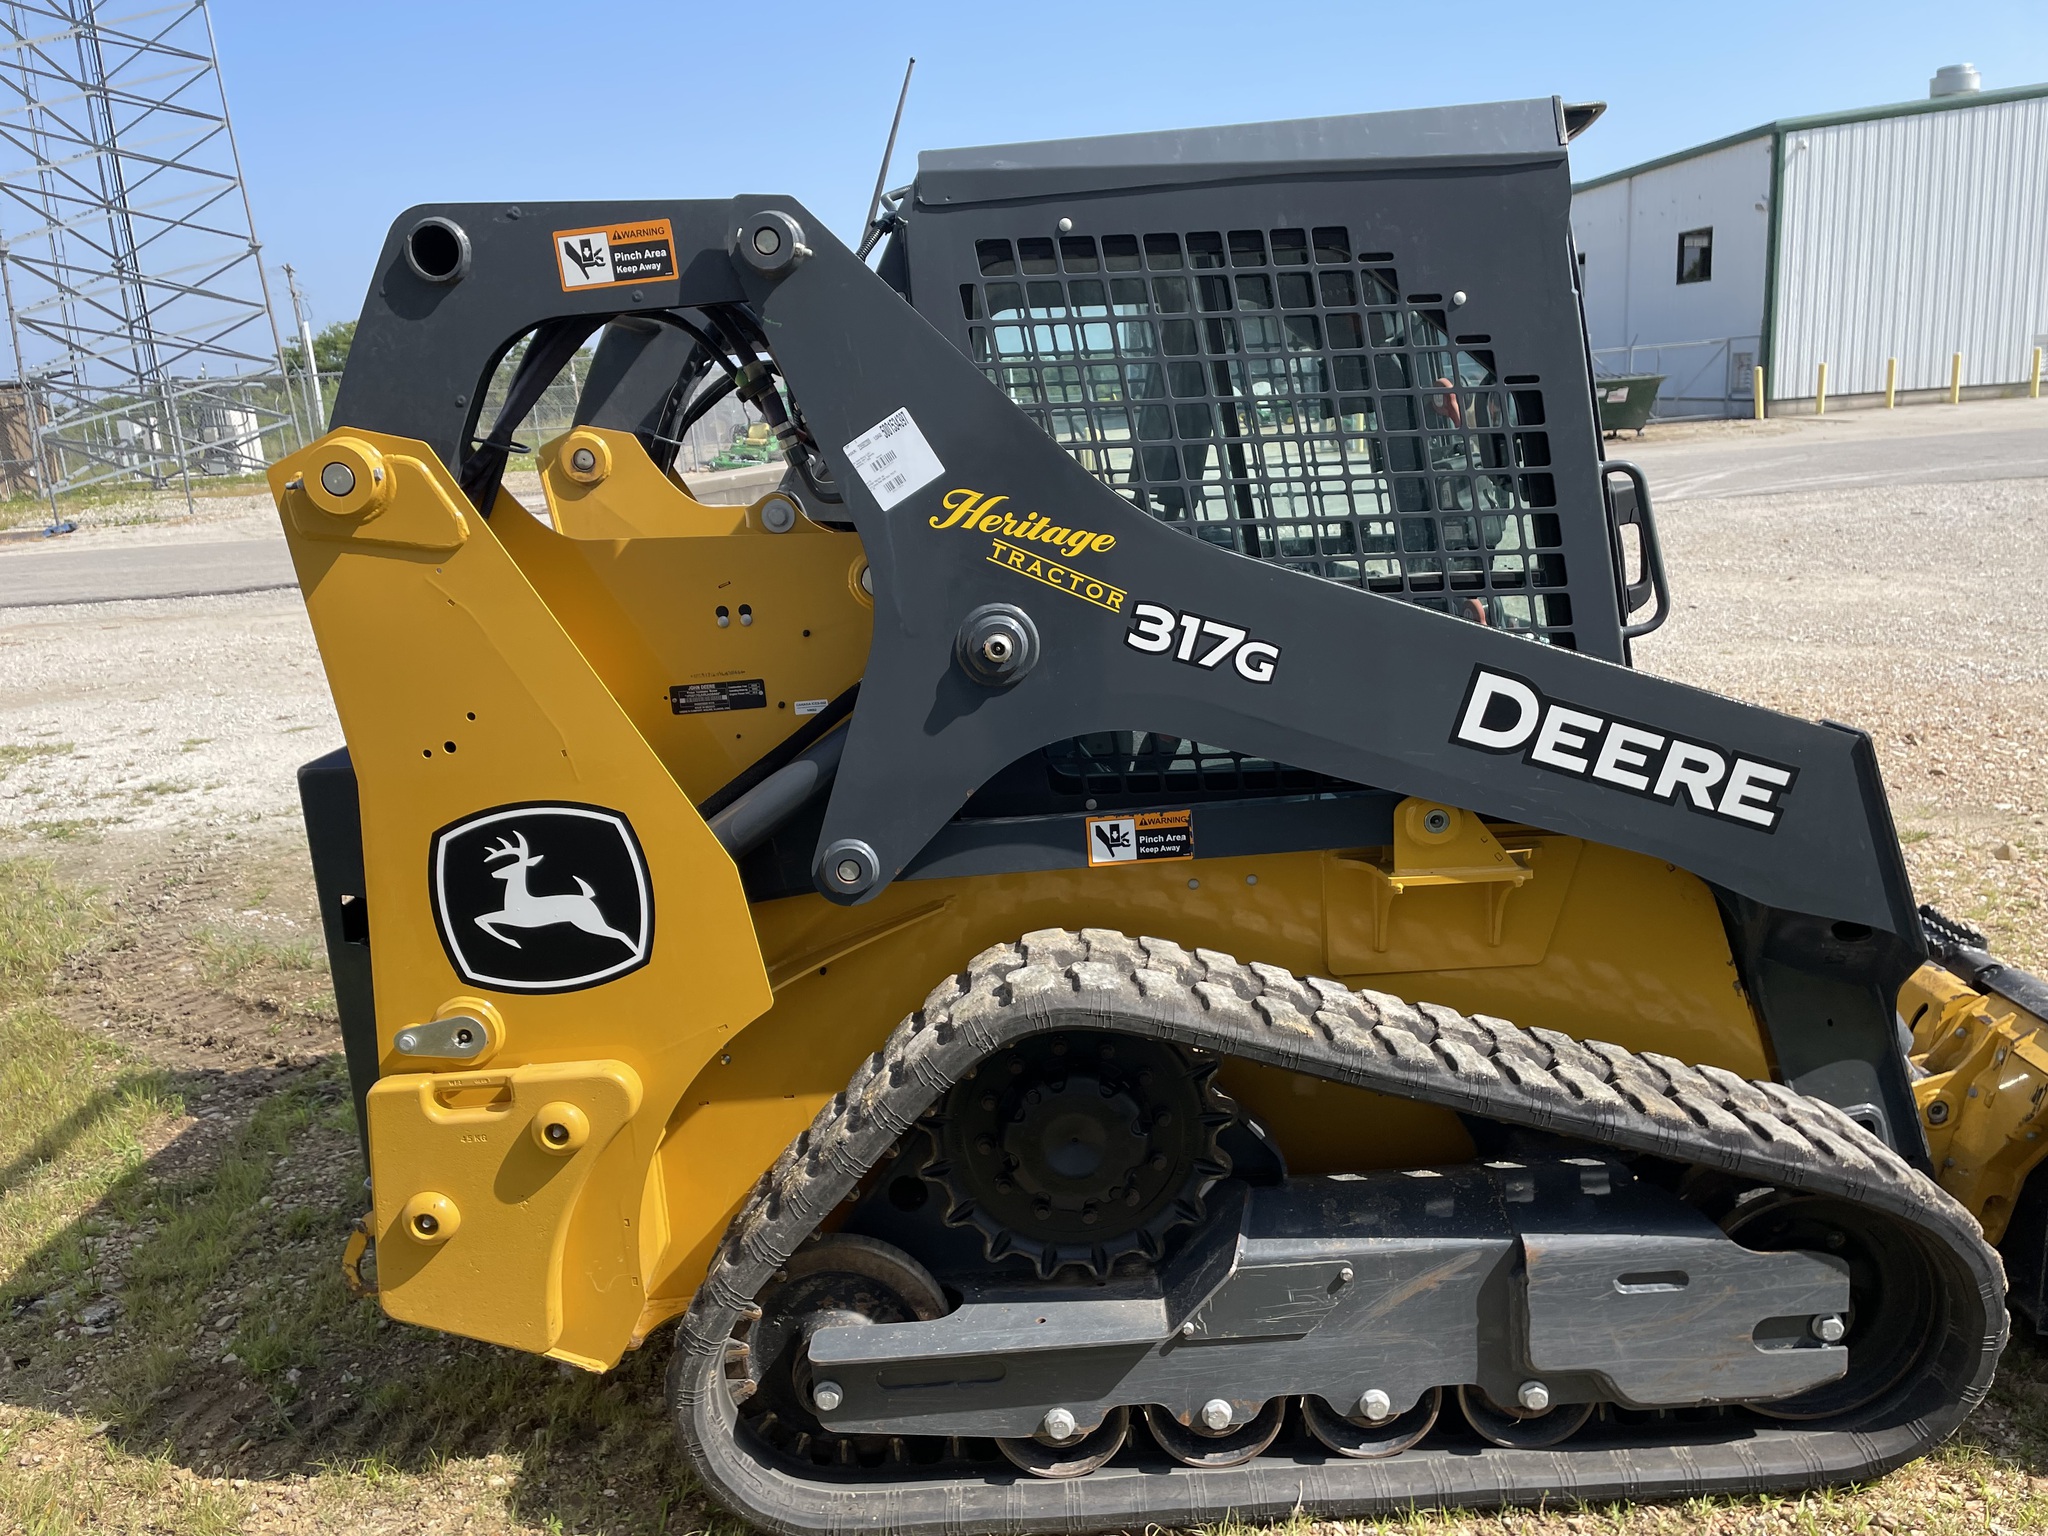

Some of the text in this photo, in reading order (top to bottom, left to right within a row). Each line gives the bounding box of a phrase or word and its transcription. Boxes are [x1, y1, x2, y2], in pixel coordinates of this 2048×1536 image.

[621, 226, 665, 239] WARNING
[614, 248, 667, 262] Pinch Area
[616, 262, 661, 274] Keep Away
[928, 488, 1117, 558] Heritage
[991, 541, 1125, 610] TRACTOR
[1127, 603, 1279, 682] 317G
[1457, 670, 1791, 827] DEERE
[1147, 815, 1187, 825] WARNING
[1139, 833, 1187, 844] Pinch Area
[1139, 844, 1181, 854] Keep Away
